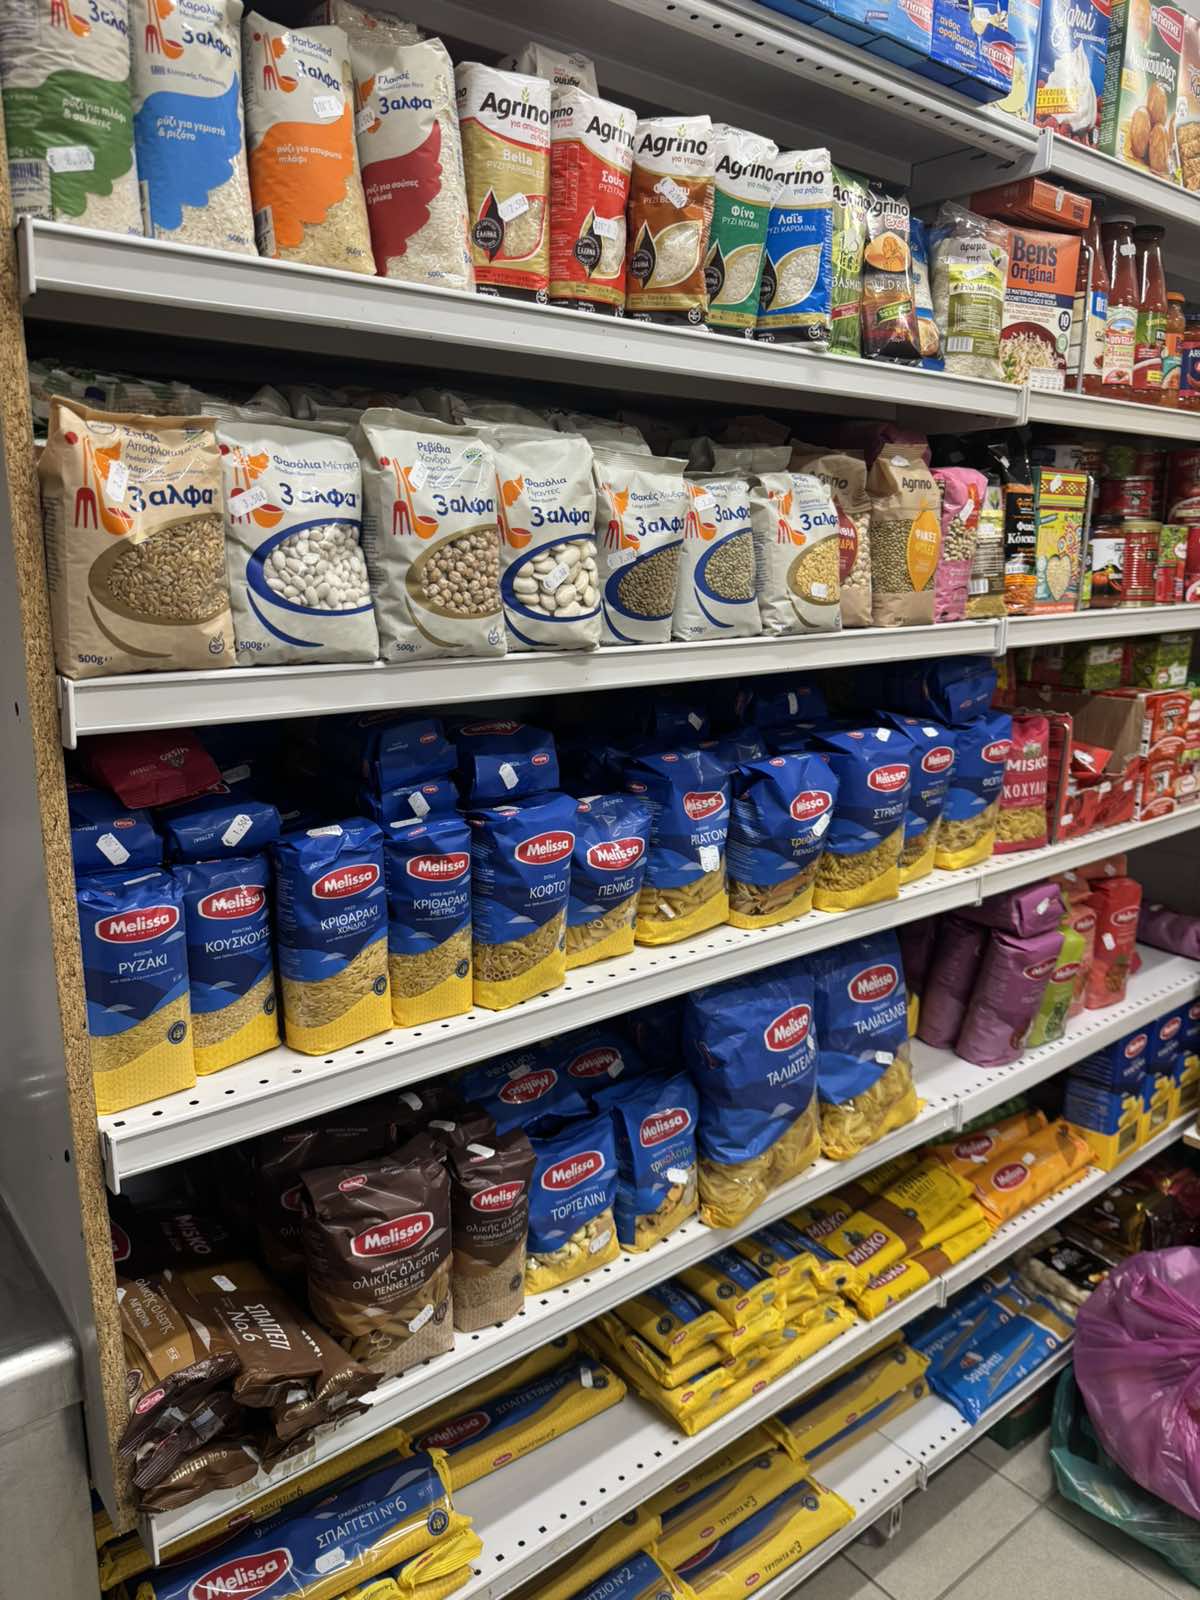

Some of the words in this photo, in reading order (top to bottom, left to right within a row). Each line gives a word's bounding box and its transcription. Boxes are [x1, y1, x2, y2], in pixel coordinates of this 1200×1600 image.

[378, 96, 433, 115] 3αλφα
[479, 91, 549, 126] Agrino
[637, 133, 708, 158] Agrino
[503, 148, 534, 167] Bella
[715, 154, 774, 182] Agrino
[774, 170, 825, 185] grino
[731, 204, 755, 219] Φίνο
[781, 224, 818, 234] ΚΑΡΟΛΙΝΑ
[1012, 235, 1058, 267] Ben's
[1011, 262, 1056, 285] Original
[416, 441, 452, 455] Ρεβίθια
[273, 455, 322, 469] Φασόλια
[525, 477, 568, 489] Φασόλια
[902, 477, 932, 493] Agrino
[127, 483, 213, 513] 3αλφα
[278, 482, 357, 508] 3αλφα
[432, 494, 496, 516] 3αλφα
[530, 505, 591, 528] 3αλφα
[240, 640, 263, 652] 500g
[396, 643, 415, 653] 500g
[78, 653, 105, 665] 500g
[1006, 755, 1048, 772] MISKO
[526, 838, 570, 858] Melissa
[596, 844, 640, 863] Melissa
[417, 858, 466, 873] Melissa
[324, 871, 373, 893] Melissa
[529, 879, 567, 900] ΚΟΦΤΟ
[598, 876, 636, 897] ΠΕΝΝΕΣ
[211, 893, 261, 913] Melissa
[413, 892, 468, 911] ΚΡΙΘΑΡΑΚΙ
[430, 907, 457, 917] ΜΕΤΡΙΟ
[109, 913, 170, 935] Melissa
[320, 904, 379, 931] ΚΡΙΘΑΡΑΚΙ
[118, 953, 168, 975] ΡΥΖΑΚΙ
[857, 973, 893, 995] Melissa
[774, 1013, 809, 1043] Melissa
[642, 1112, 684, 1140] Melissa
[552, 1157, 595, 1184] Melissa
[551, 1190, 606, 1221] ΤΟΡΤΕΛΙΝΙ
[364, 1219, 424, 1250] Melissa
[806, 1211, 848, 1240] MISKO
[847, 1231, 887, 1265] MISKO
[352, 1268, 398, 1291] ολικής
[399, 1247, 441, 1276] άλεσης
[374, 1278, 409, 1298] ΠΕΝΝΕΣ
[409, 1268, 426, 1283] ΡΙΓΕ
[243, 1302, 293, 1351] ΣΠΑΓΓΕΤΙ
[963, 1352, 1004, 1384] Spaghetti
[315, 1510, 380, 1550] ΣΠΑΓΓΕΤΙ
[205, 1556, 280, 1598] Melissa
